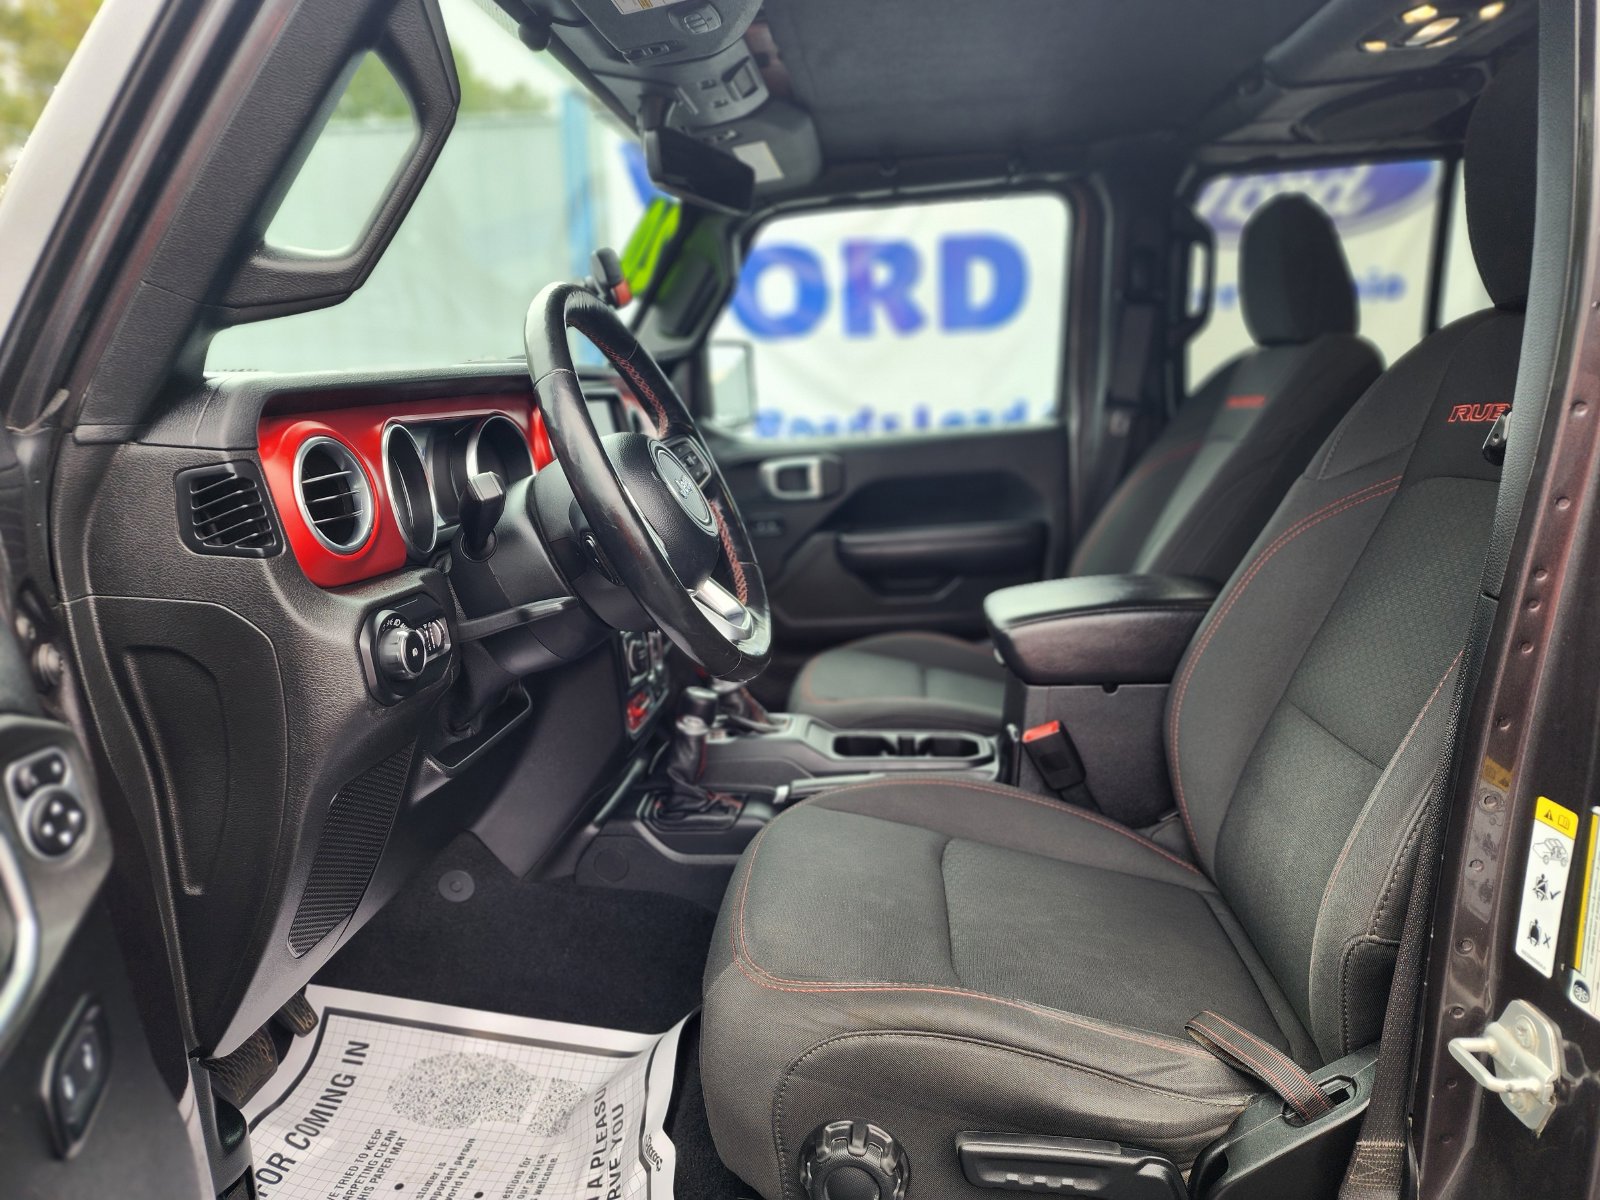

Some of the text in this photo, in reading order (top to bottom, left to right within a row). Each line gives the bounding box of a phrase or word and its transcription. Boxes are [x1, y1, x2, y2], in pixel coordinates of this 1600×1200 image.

[732, 231, 1030, 342] ORD
[255, 1040, 370, 1199] FOR COMING IN
[374, 1129, 398, 1158] CLEAN
[610, 1103, 624, 1153] YOU
[334, 1165, 359, 1189] TRIED
[354, 1152, 369, 1163] TO
[364, 1128, 383, 1151] KEEP
[369, 1157, 396, 1184] PAPER
[389, 1136, 408, 1155] MAT
[454, 1138, 476, 1166] person
[519, 1156, 533, 1168] for
[587, 1174, 603, 1189] A
